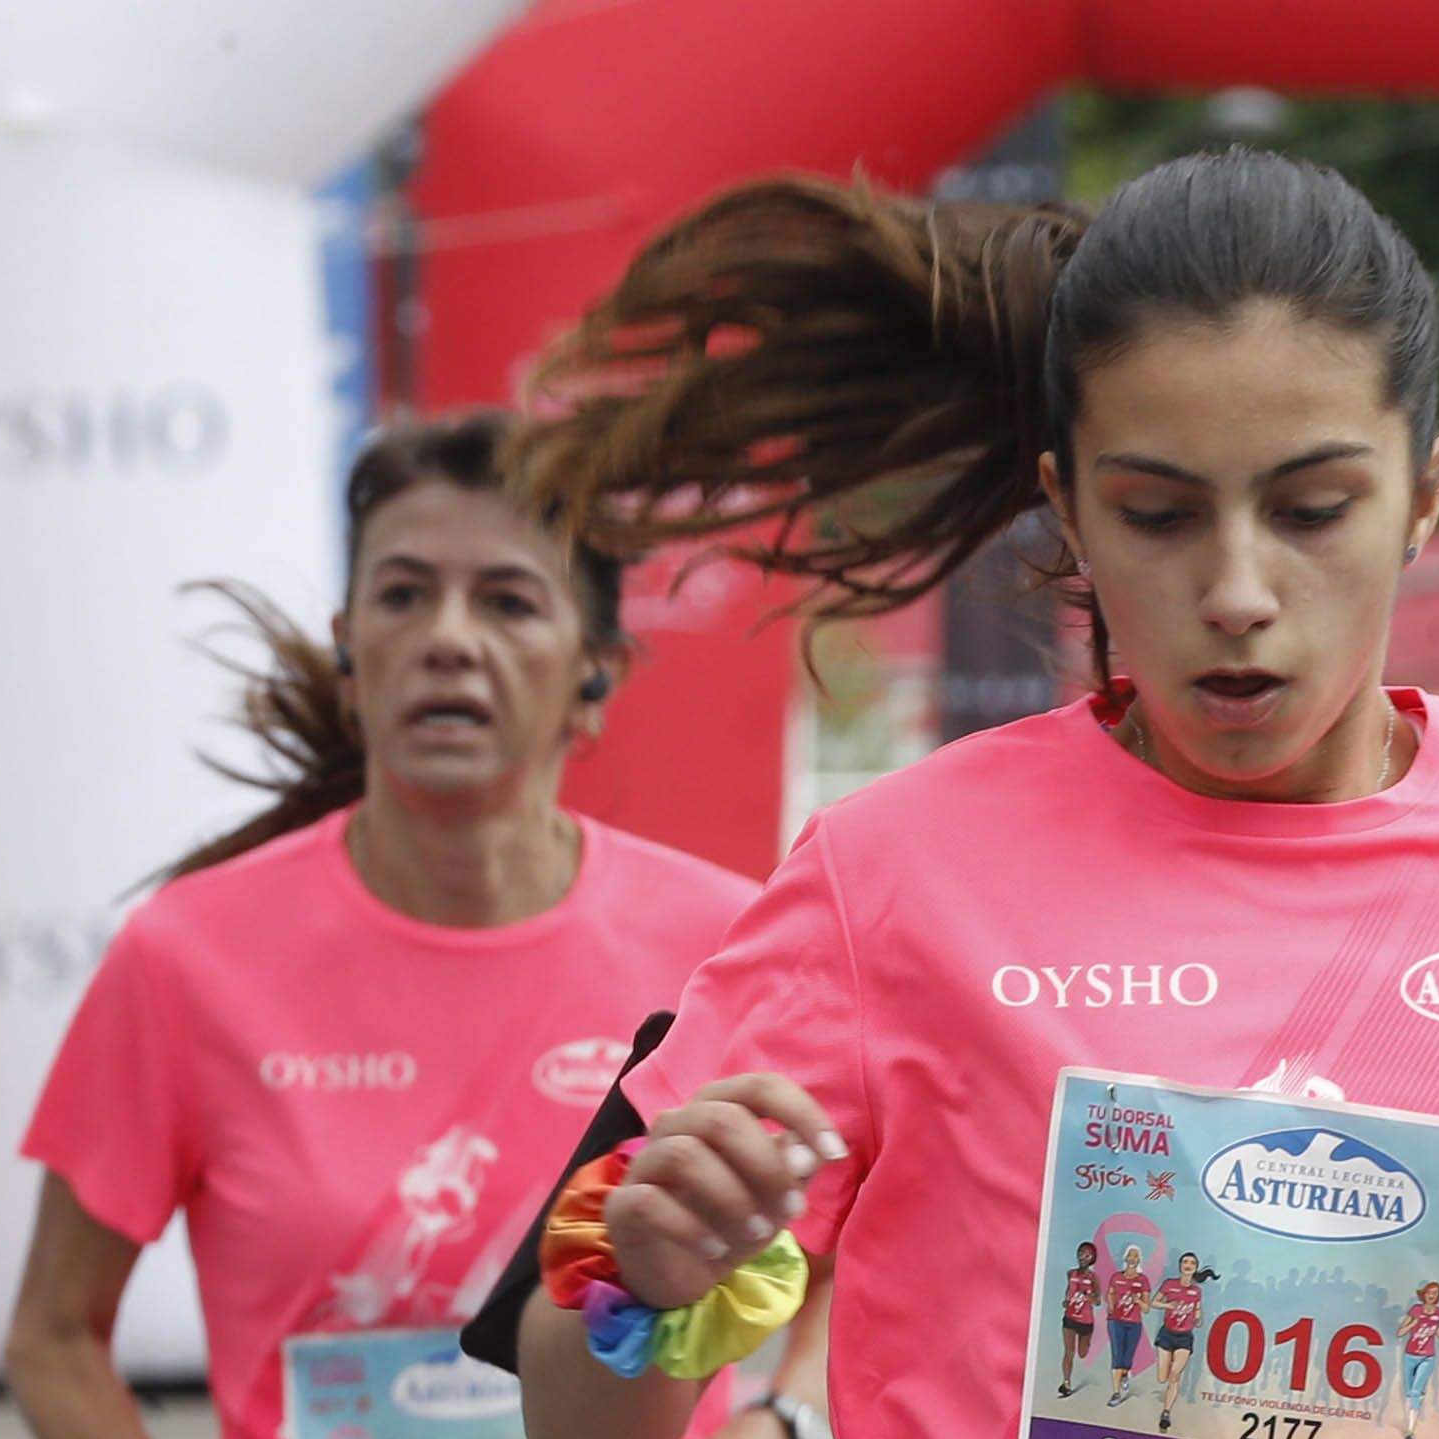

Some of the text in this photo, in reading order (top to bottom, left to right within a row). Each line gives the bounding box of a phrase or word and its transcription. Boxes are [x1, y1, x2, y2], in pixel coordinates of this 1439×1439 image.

[992, 962, 1218, 1008] OYSHO
[260, 1051, 416, 1089] OYSHO
[1087, 1104, 1175, 1129] TU DORSAL
[1085, 1122, 1170, 1157] SUMA
[1074, 1163, 1138, 1192] gijón
[1218, 1159, 1406, 1223] ASTURIANA
[1256, 1159, 1406, 1190] CENTRAL LECHERA
[1206, 1309, 1384, 1399] 016
